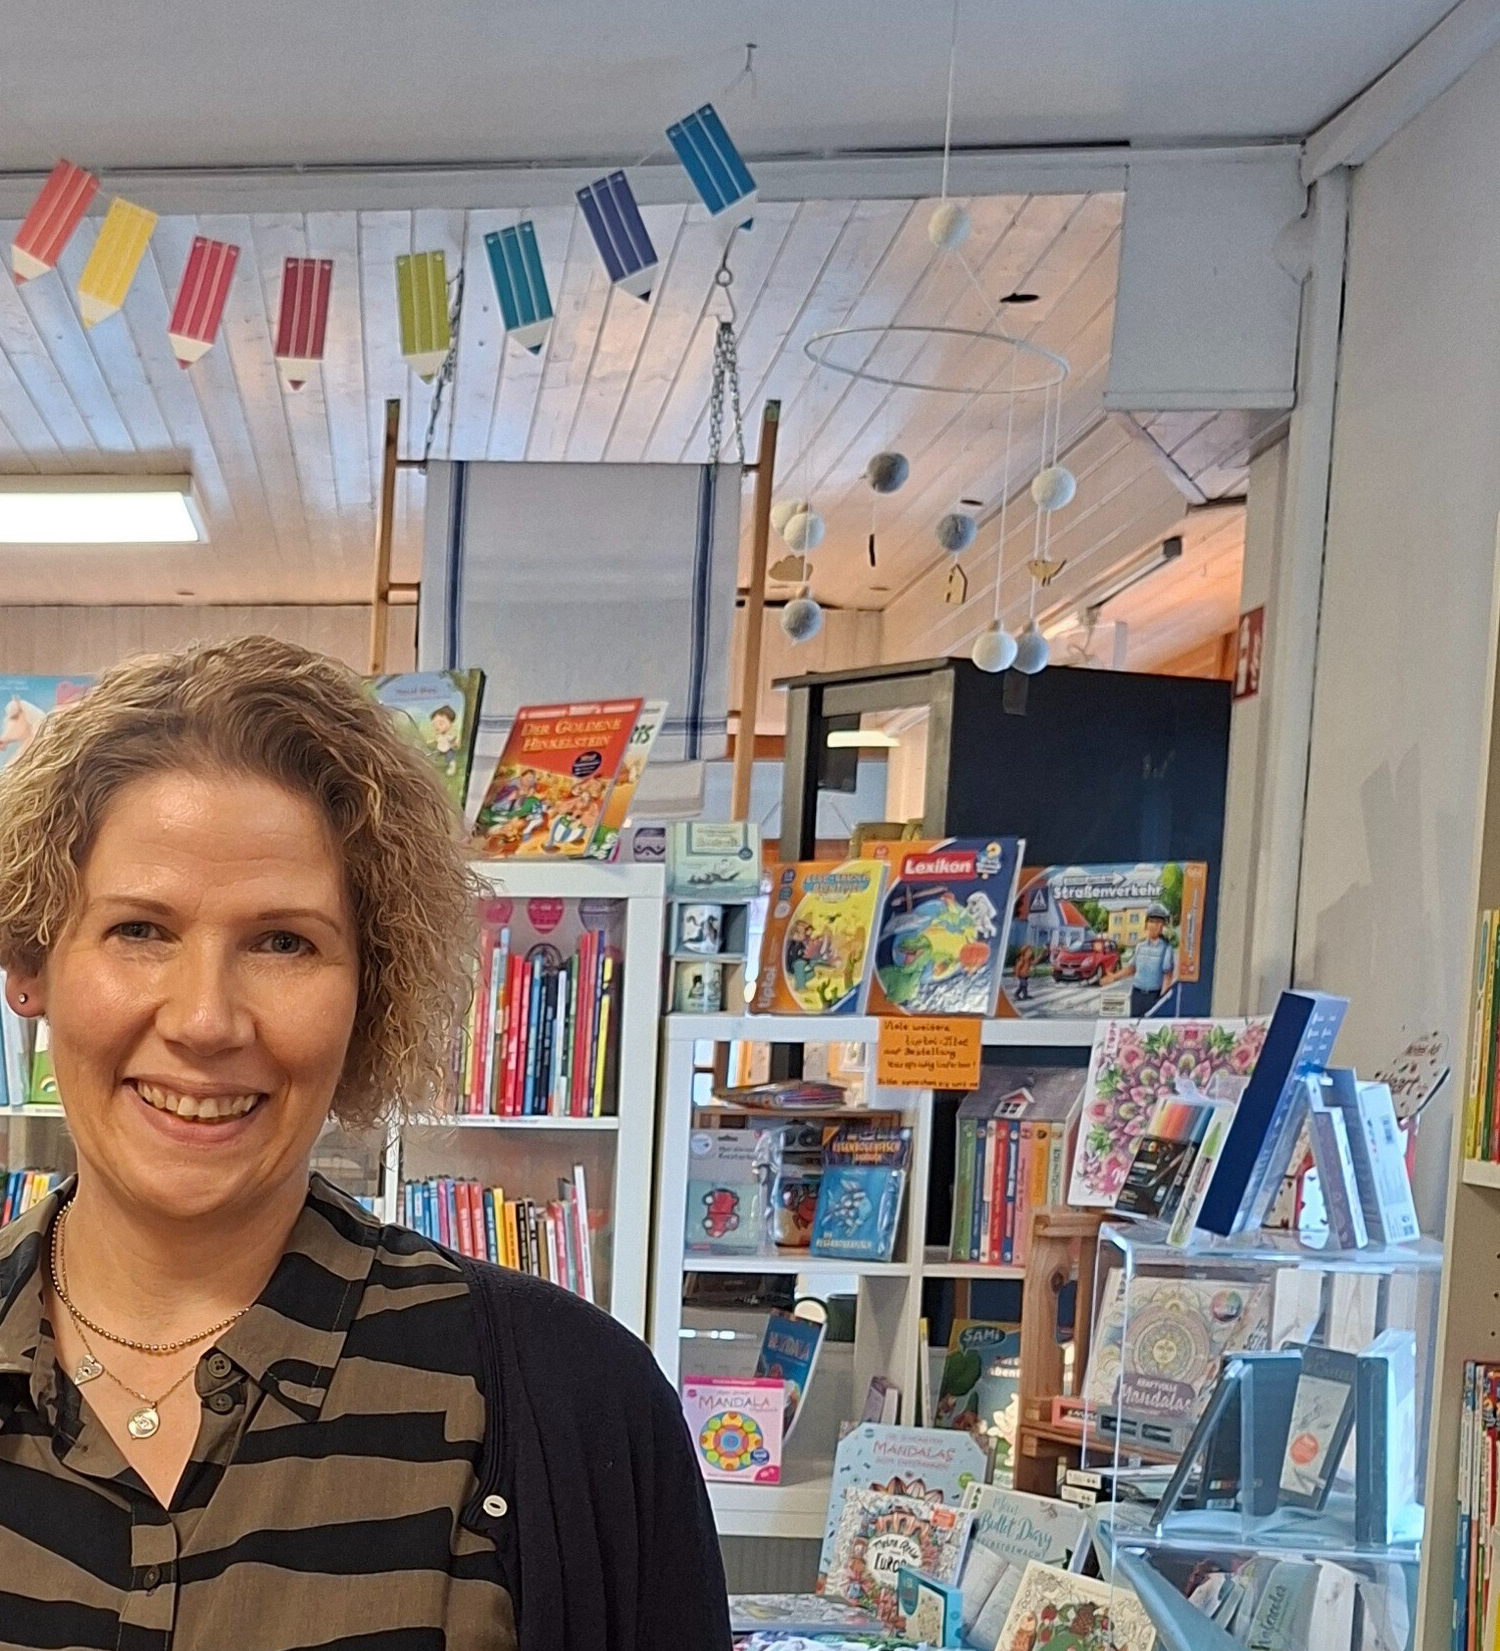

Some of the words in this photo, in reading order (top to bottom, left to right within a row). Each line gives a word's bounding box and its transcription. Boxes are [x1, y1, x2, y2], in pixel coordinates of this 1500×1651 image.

[521, 723, 550, 737] DER
[554, 718, 622, 734] GOLDENE
[523, 736, 612, 752] HINKELSTEIN
[904, 859, 972, 875] Lexikon
[1053, 885, 1162, 900] Straßenverkehr
[699, 1396, 769, 1410] MANDALA
[873, 1441, 956, 1460] MANDALAS
